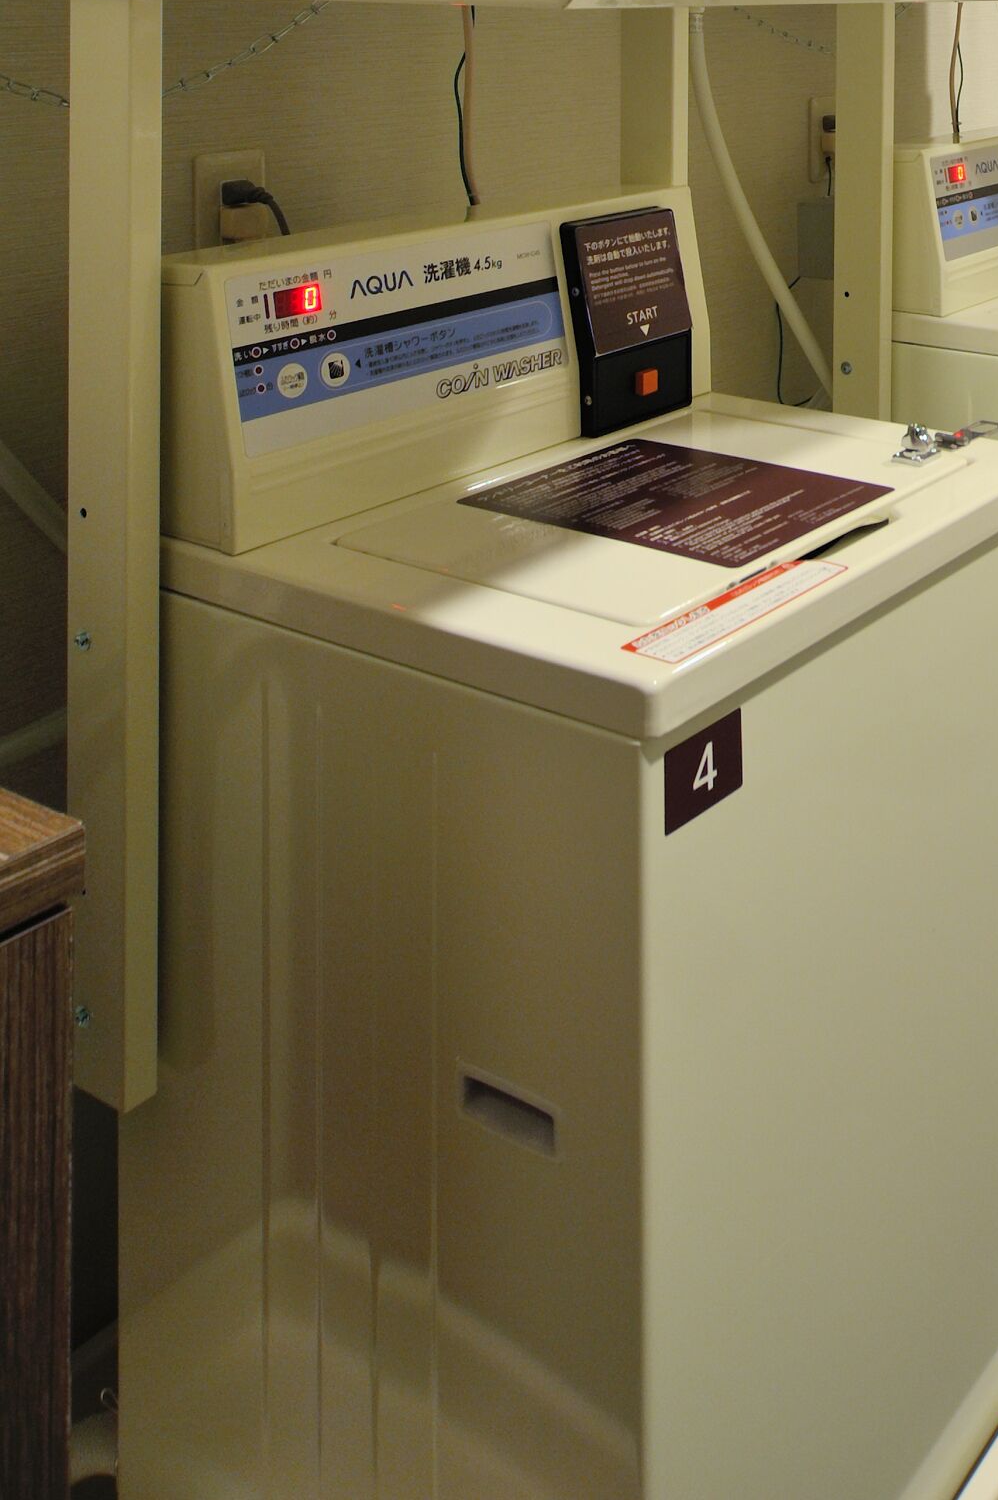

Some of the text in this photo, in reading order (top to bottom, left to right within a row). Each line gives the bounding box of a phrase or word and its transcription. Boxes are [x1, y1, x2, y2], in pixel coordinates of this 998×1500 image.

[958, 166, 964, 180] 0
[258, 269, 332, 291] ただいまの金額 円
[350, 256, 502, 300] AQUA 洗濯機 4.5kg
[304, 286, 317, 309] 0
[329, 310, 337, 321] 分
[627, 305, 658, 325] START
[493, 348, 563, 383] WASHER
[693, 740, 718, 791] 4
